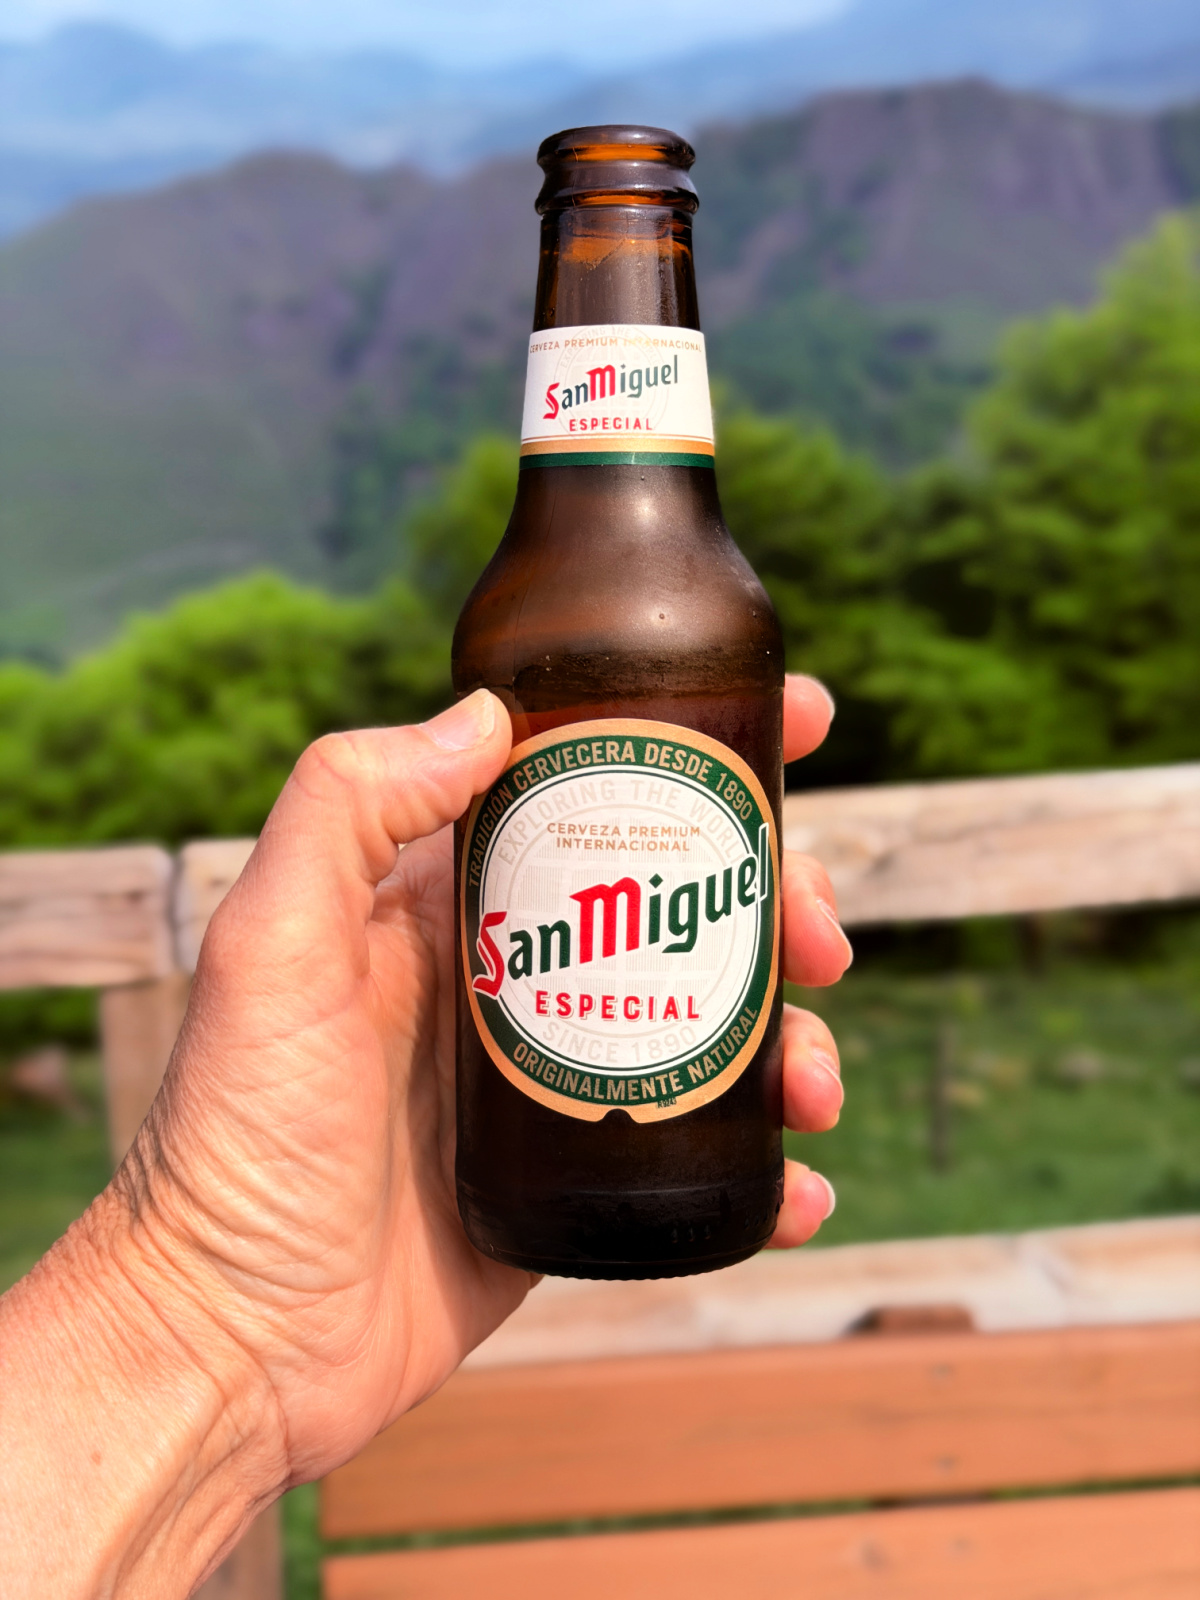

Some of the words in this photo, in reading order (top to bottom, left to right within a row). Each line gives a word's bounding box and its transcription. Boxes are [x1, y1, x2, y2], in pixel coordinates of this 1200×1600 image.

[529, 340, 560, 354] CERVEZA
[564, 338, 618, 348] PREMIUM
[569, 416, 653, 432] ESPECIAL
[469, 783, 513, 888] TRADICIÓN
[513, 741, 636, 791] CERVECERA
[643, 742, 713, 782] DESDE
[715, 772, 753, 821] 1890
[497, 779, 616, 866] EXPLORING
[630, 779, 681, 809] THE
[547, 822, 621, 836] CERVEZA
[628, 826, 700, 838] PREMIUM
[556, 837, 690, 851] INTERNACIONAL
[535, 989, 701, 1021] ESPECIAL
[513, 1042, 684, 1101] ORIGINALMENTE
[687, 1005, 758, 1084] NATURAL
[542, 1022, 618, 1063] SINCE
[631, 1025, 698, 1063] 1890
